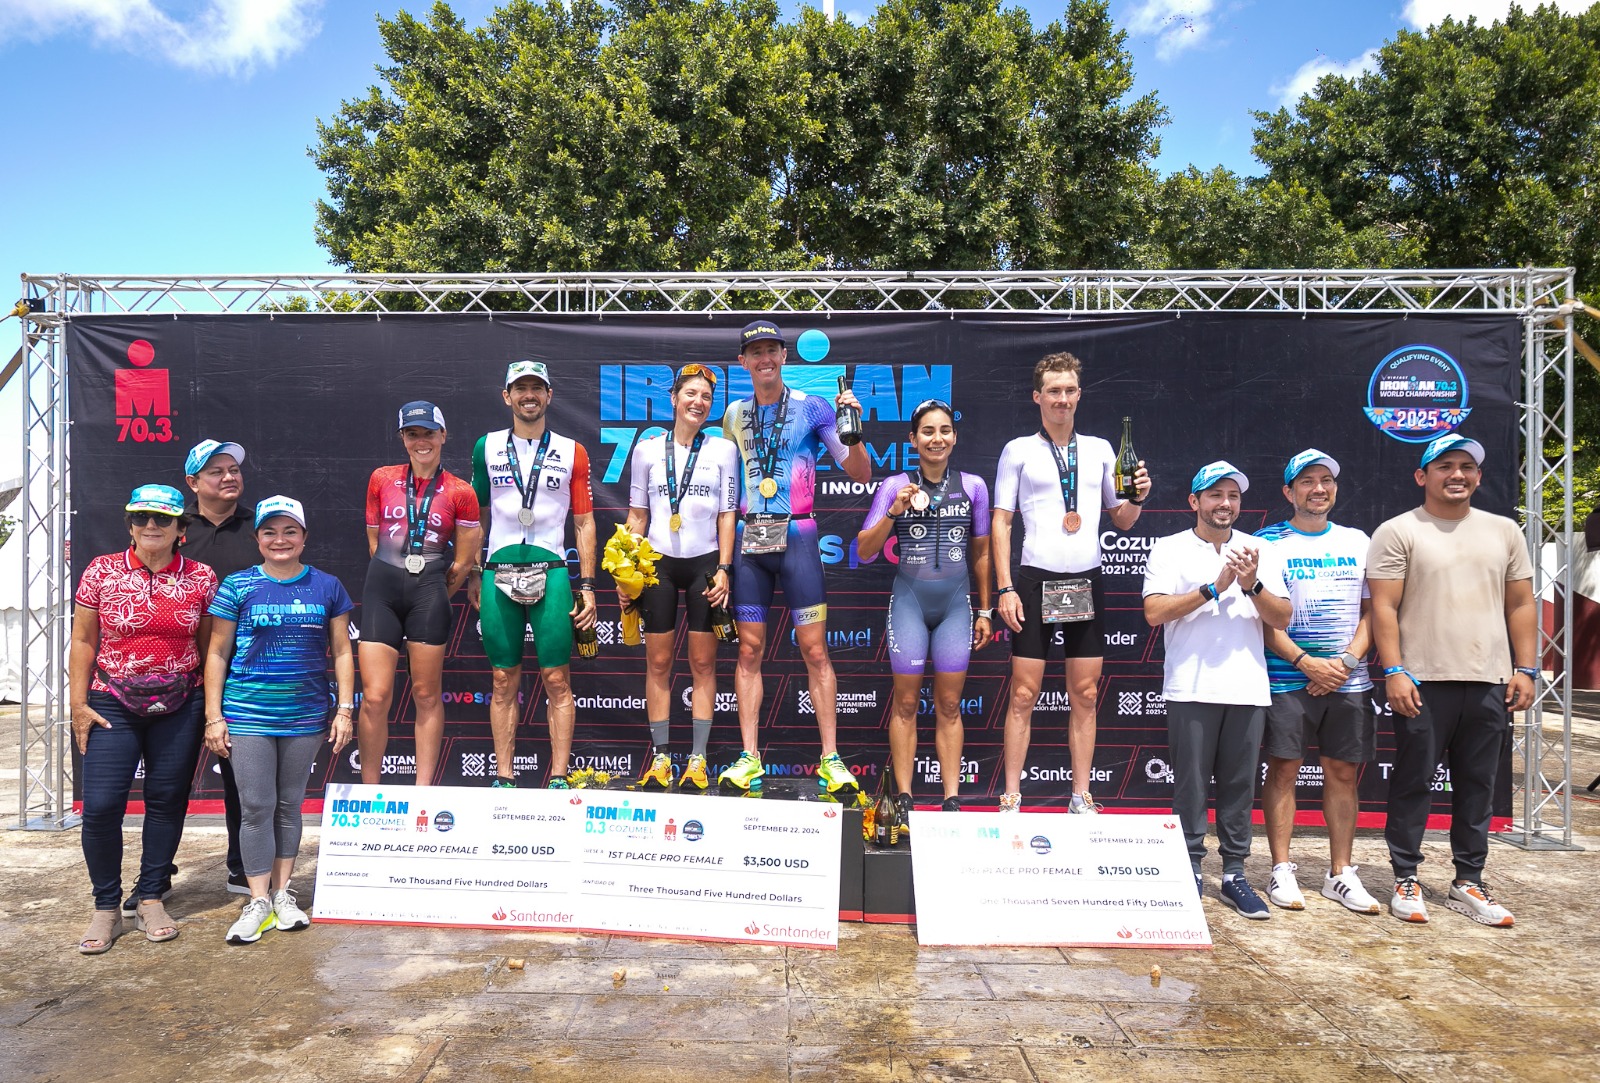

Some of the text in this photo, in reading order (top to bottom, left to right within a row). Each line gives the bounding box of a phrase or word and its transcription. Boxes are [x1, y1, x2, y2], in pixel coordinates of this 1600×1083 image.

[1389, 353, 1451, 373] QUALIFYING EVENT
[1380, 378, 1457, 391] IRONMAN 70.3
[1380, 390, 1457, 398] WORLD CHAMPIONSHIP
[1396, 410, 1438, 427] 2025
[115, 417, 173, 443] 70.3
[658, 484, 711, 498] PEERER
[728, 476, 736, 510] FUSION
[384, 505, 442, 527] LOS
[759, 526, 767, 538] 3
[1100, 530, 1156, 550] Cozu
[1100, 553, 1148, 563] AYUNTA
[1287, 552, 1357, 569] IRONMAN
[1288, 568, 1316, 581] 70.3
[511, 577, 528, 589] 16
[1062, 593, 1071, 605] 4
[250, 598, 326, 616] IRONMAN
[251, 614, 282, 628] 70.3
[1055, 630, 1138, 646] Snder
[577, 639, 599, 656] BRUT
[836, 690, 877, 701] ozumel
[913, 755, 979, 774] riaón
[924, 772, 966, 783] MÉO
[1029, 766, 1113, 782] Santder
[332, 793, 409, 814] IRONMAN
[492, 813, 536, 821] SEPTEMBER
[536, 814, 548, 822] 22,
[586, 800, 657, 822] RONMAN
[331, 813, 406, 828] 70.3 COZUMEL
[585, 820, 654, 835] 0.3 COZUMEL
[743, 823, 788, 833] SEPTEMBER
[802, 827, 820, 835] 2024
[361, 843, 479, 855] 2ND PLACE PRO FEMALE
[491, 844, 555, 856] $2,500 USD
[608, 850, 724, 866] 1ST PLACE PRO FEMALE
[743, 855, 810, 869] $3,500 USD
[1018, 867, 1040, 875] PRO
[1042, 867, 1084, 876] FEMALE
[1097, 865, 1160, 877] $1,750 USD
[388, 875, 548, 889] Two Thousand Five Hundred Dollars
[628, 884, 803, 904] Three Thousand Five Hundred Dollars
[1002, 897, 1049, 906] Thousand
[1051, 898, 1080, 906] Seven
[1082, 898, 1124, 907] Hundred
[1126, 899, 1148, 909] Fifty
[1150, 899, 1184, 908] Dollars
[509, 908, 574, 923] Santander
[762, 923, 832, 940] Santander
[1135, 927, 1204, 941] Santander
